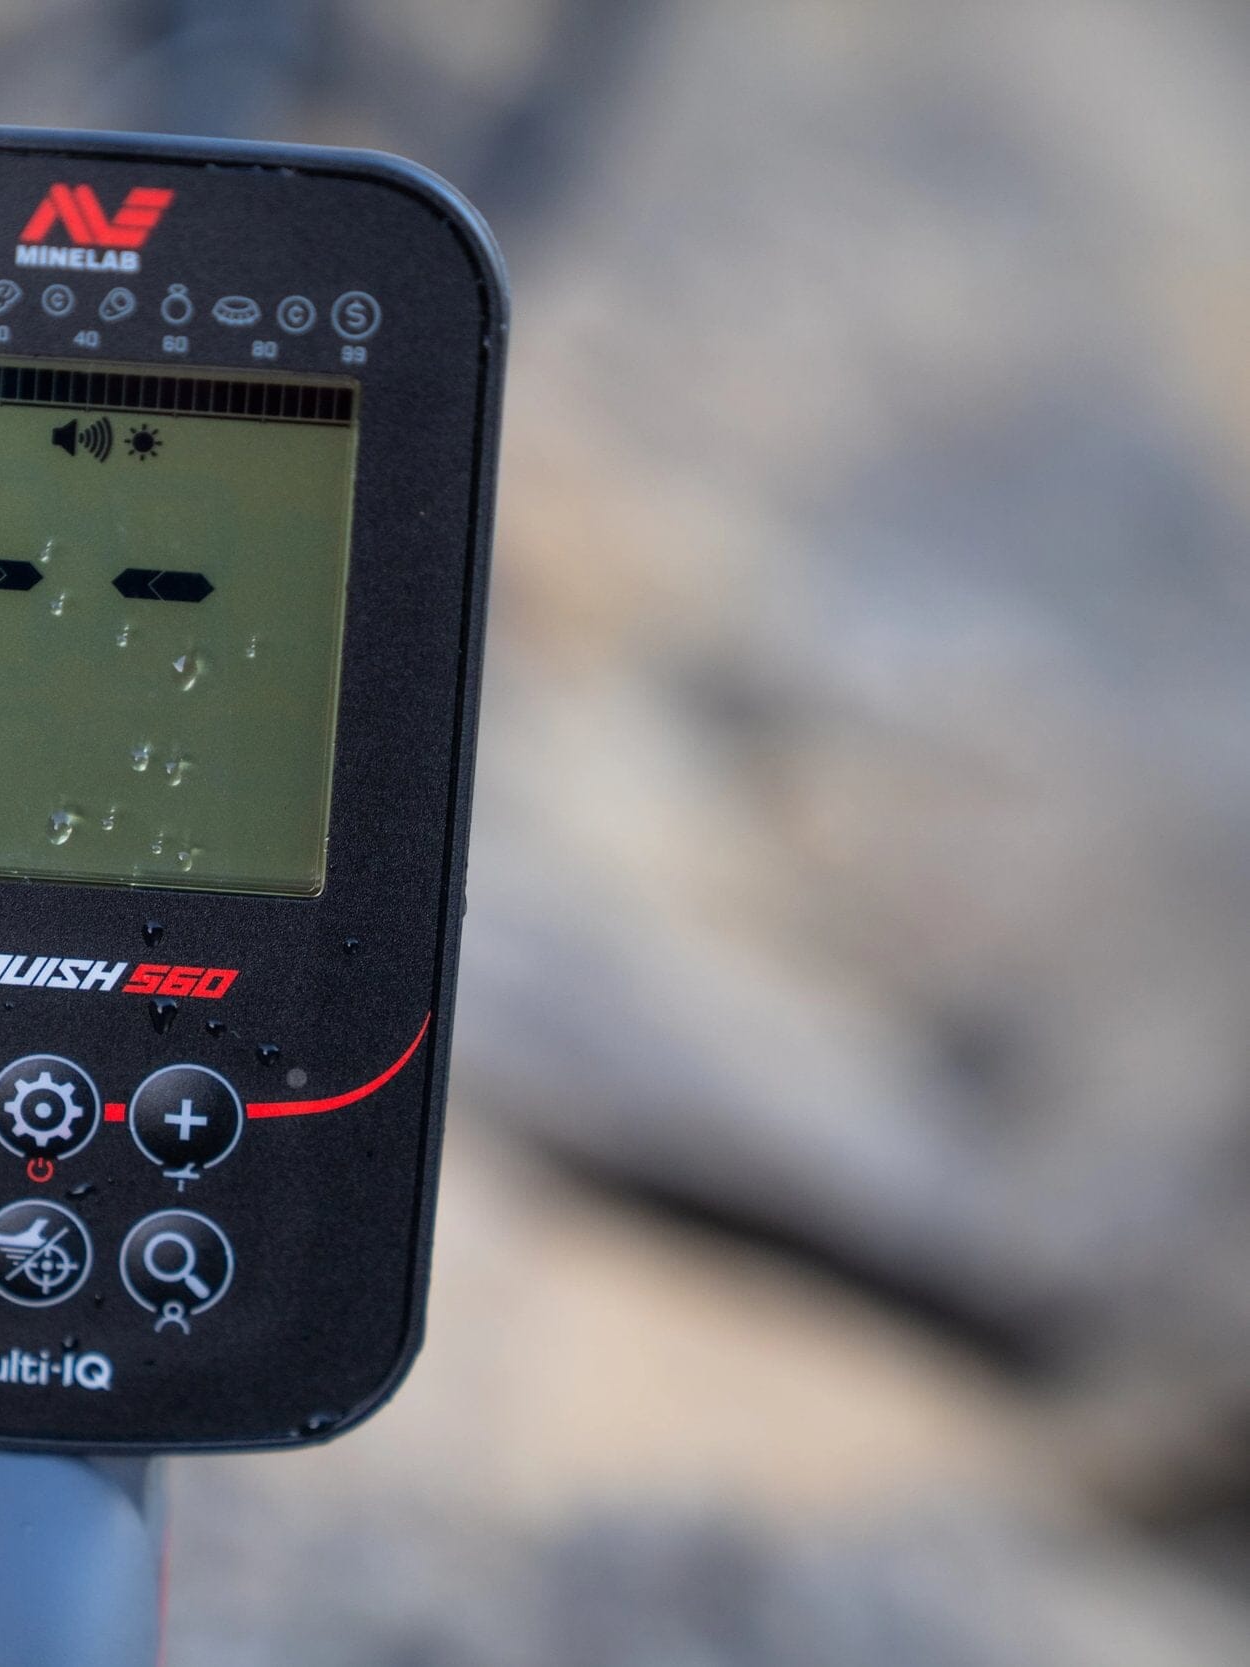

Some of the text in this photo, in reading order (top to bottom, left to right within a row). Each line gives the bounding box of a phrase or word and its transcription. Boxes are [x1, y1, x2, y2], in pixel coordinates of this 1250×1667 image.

[15, 245, 141, 273] MINELAB
[73, 330, 100, 348] 40
[162, 335, 188, 353] 60
[121, 963, 240, 999] 560
